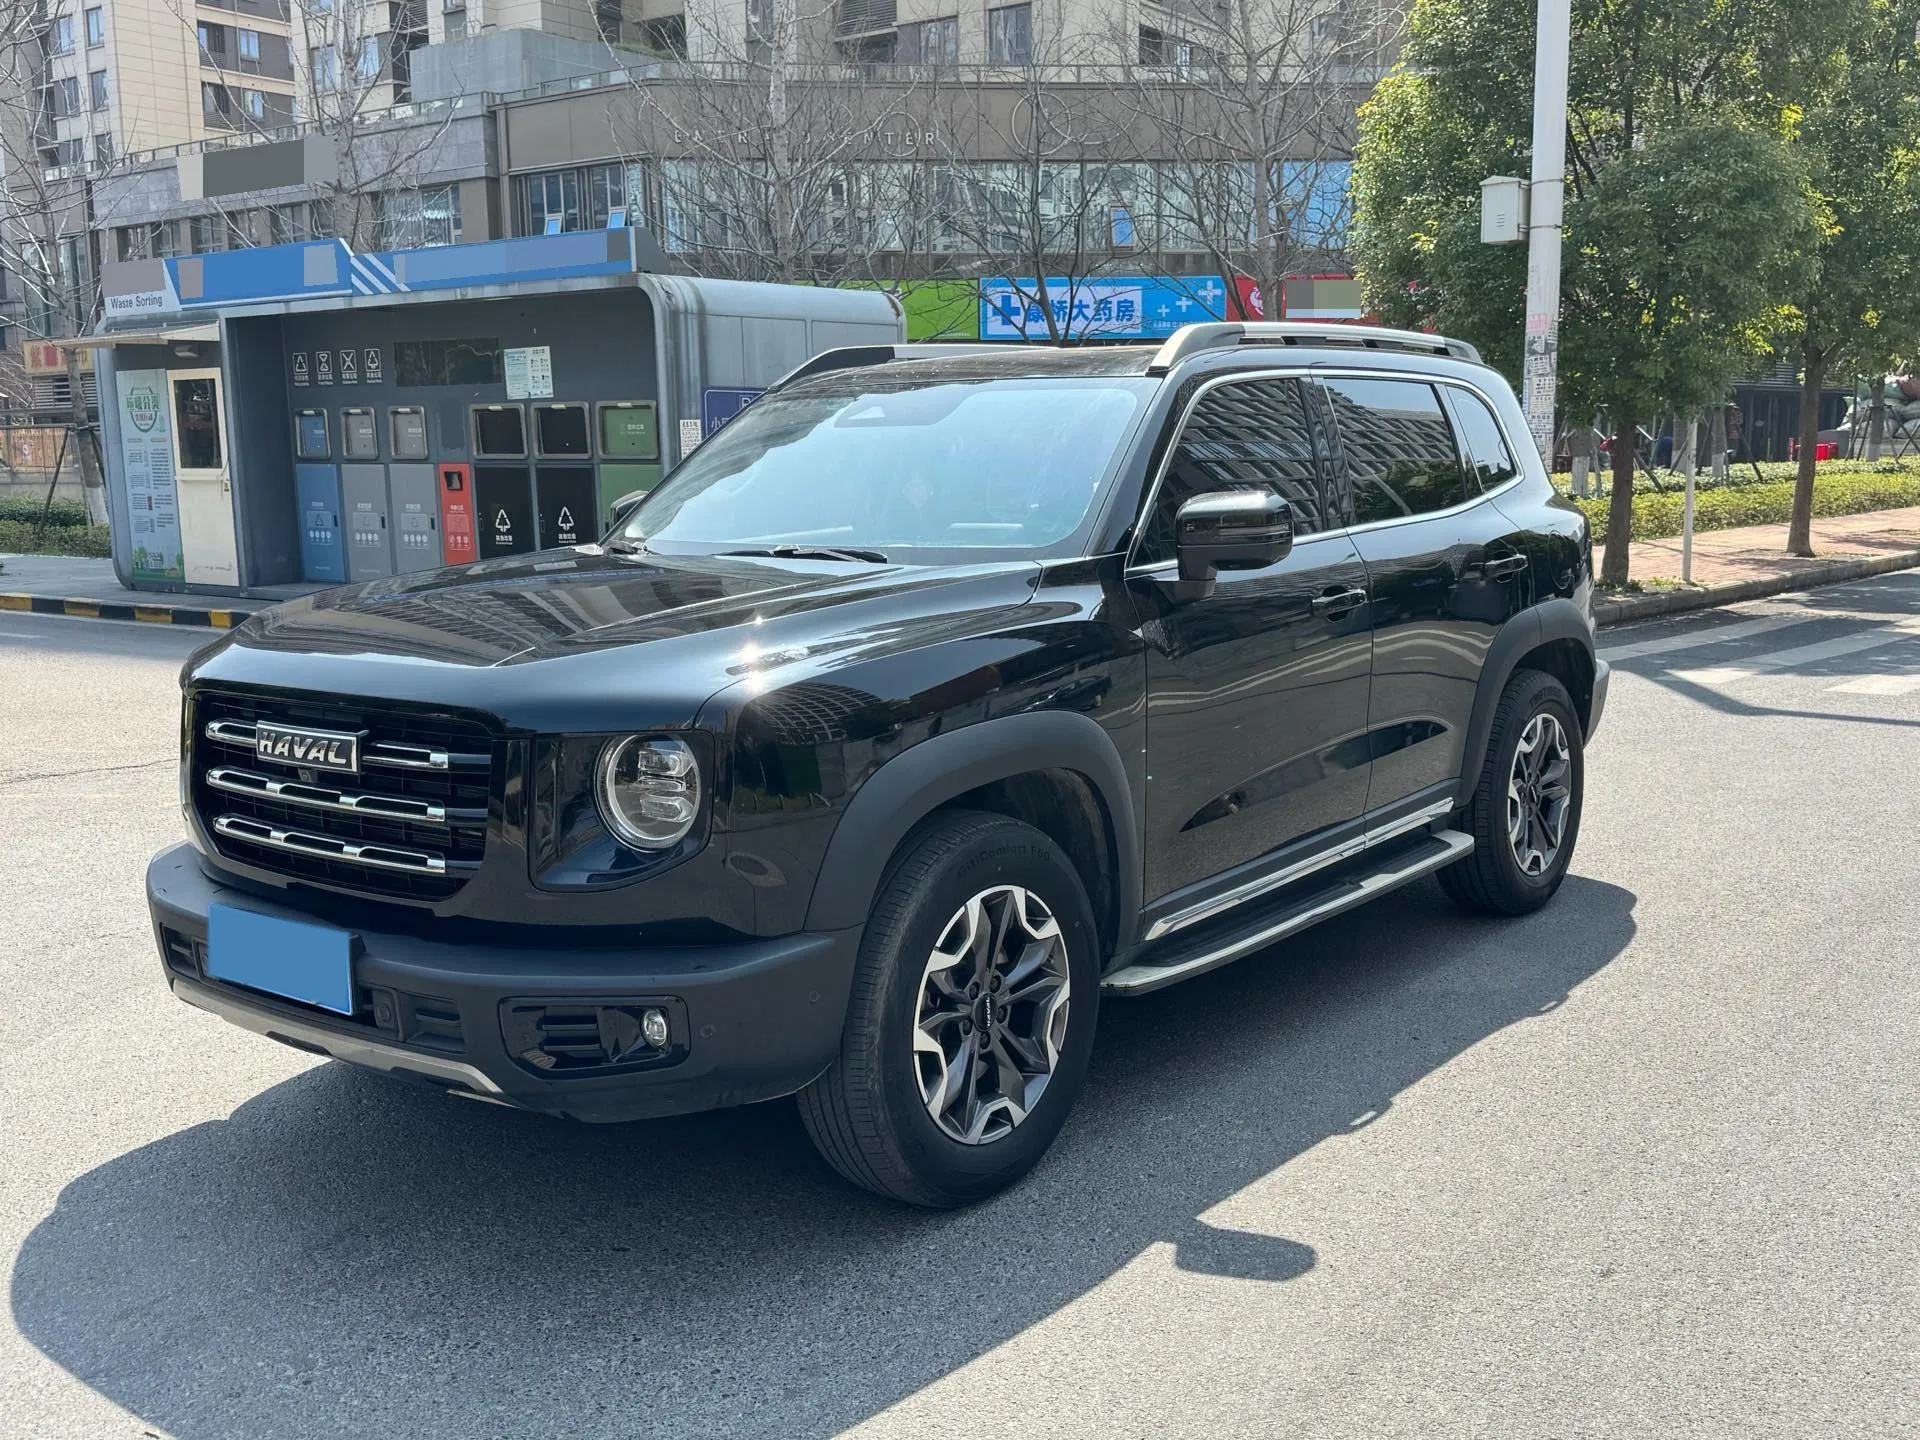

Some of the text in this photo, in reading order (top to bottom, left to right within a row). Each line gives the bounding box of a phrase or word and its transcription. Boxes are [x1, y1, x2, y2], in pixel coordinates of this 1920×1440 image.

[110, 294, 163, 309] Waste Sorting
[259, 732, 347, 764] HAVAL
